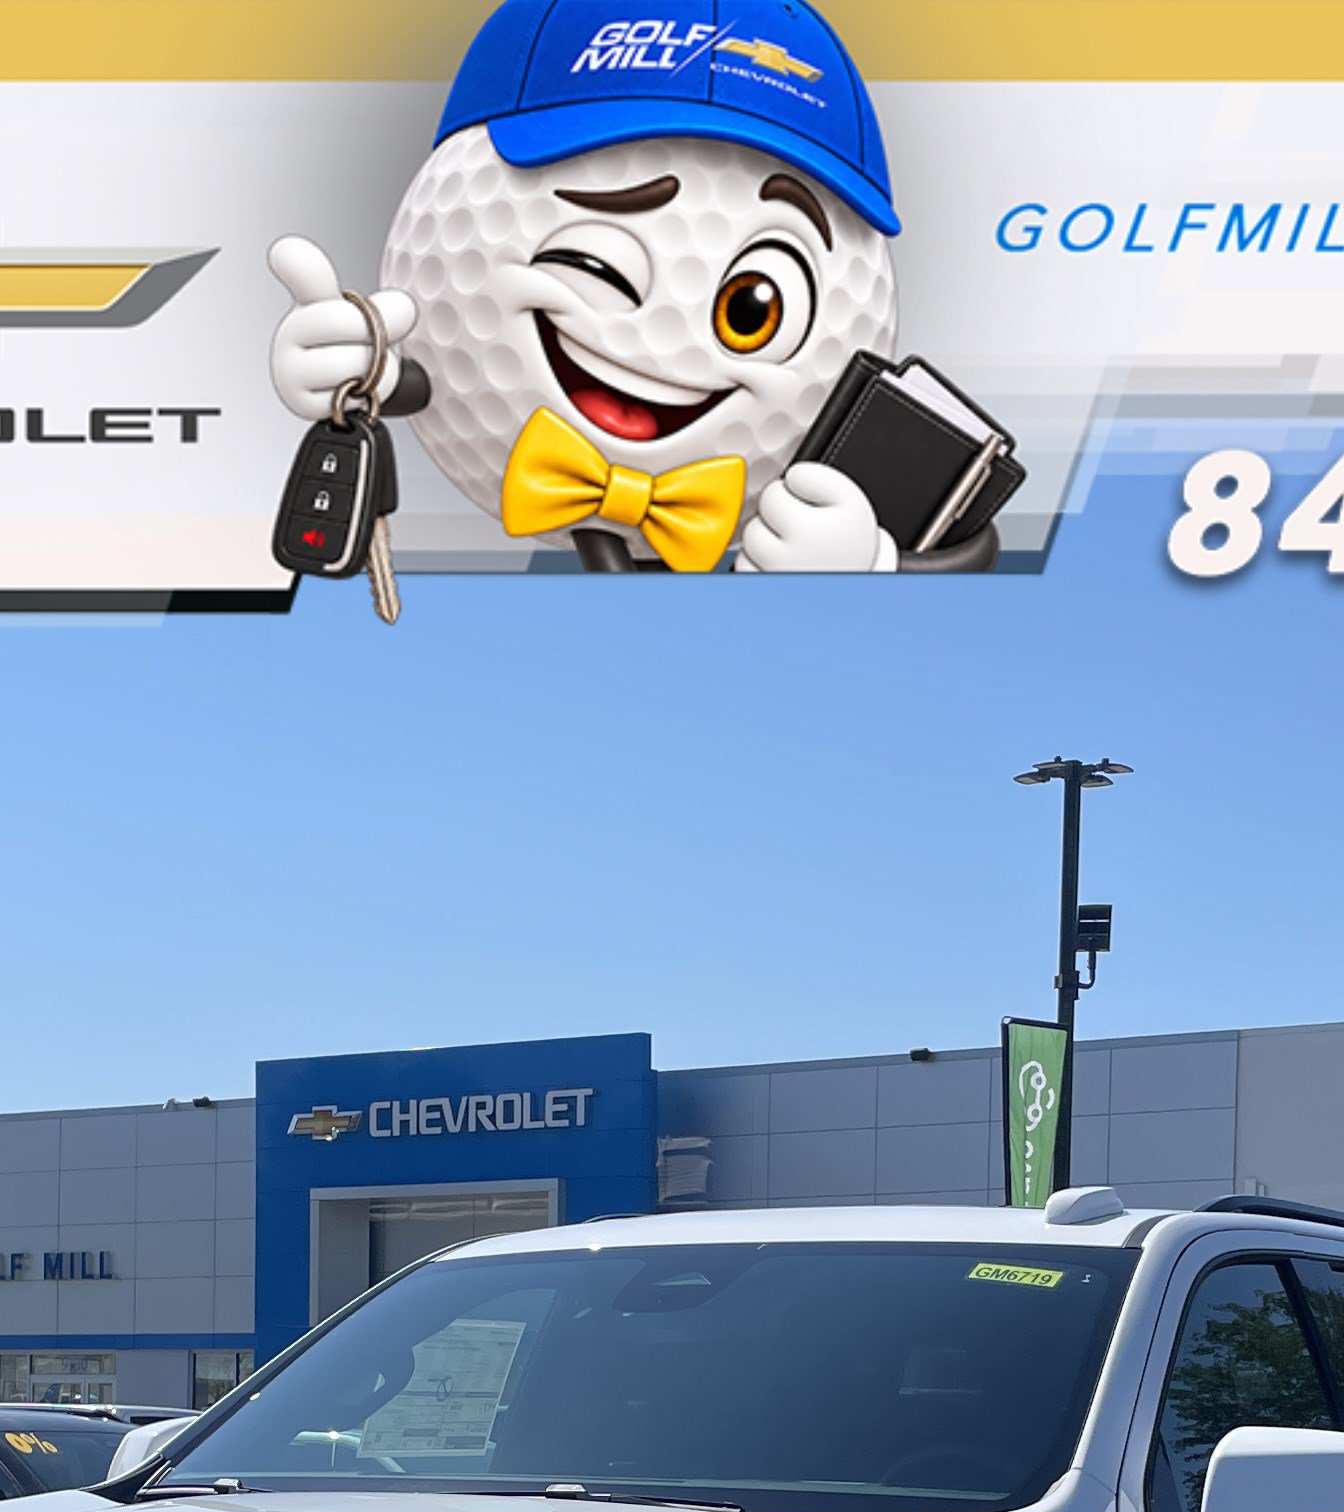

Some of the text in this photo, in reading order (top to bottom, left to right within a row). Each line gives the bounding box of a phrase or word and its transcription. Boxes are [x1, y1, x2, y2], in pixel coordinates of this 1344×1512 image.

[369, 1088, 593, 1138] CHEVROLET
[43, 1251, 113, 1281] MILL
[976, 1267, 1053, 1284] GM6719
[4, 1432, 58, 1454] 0%
